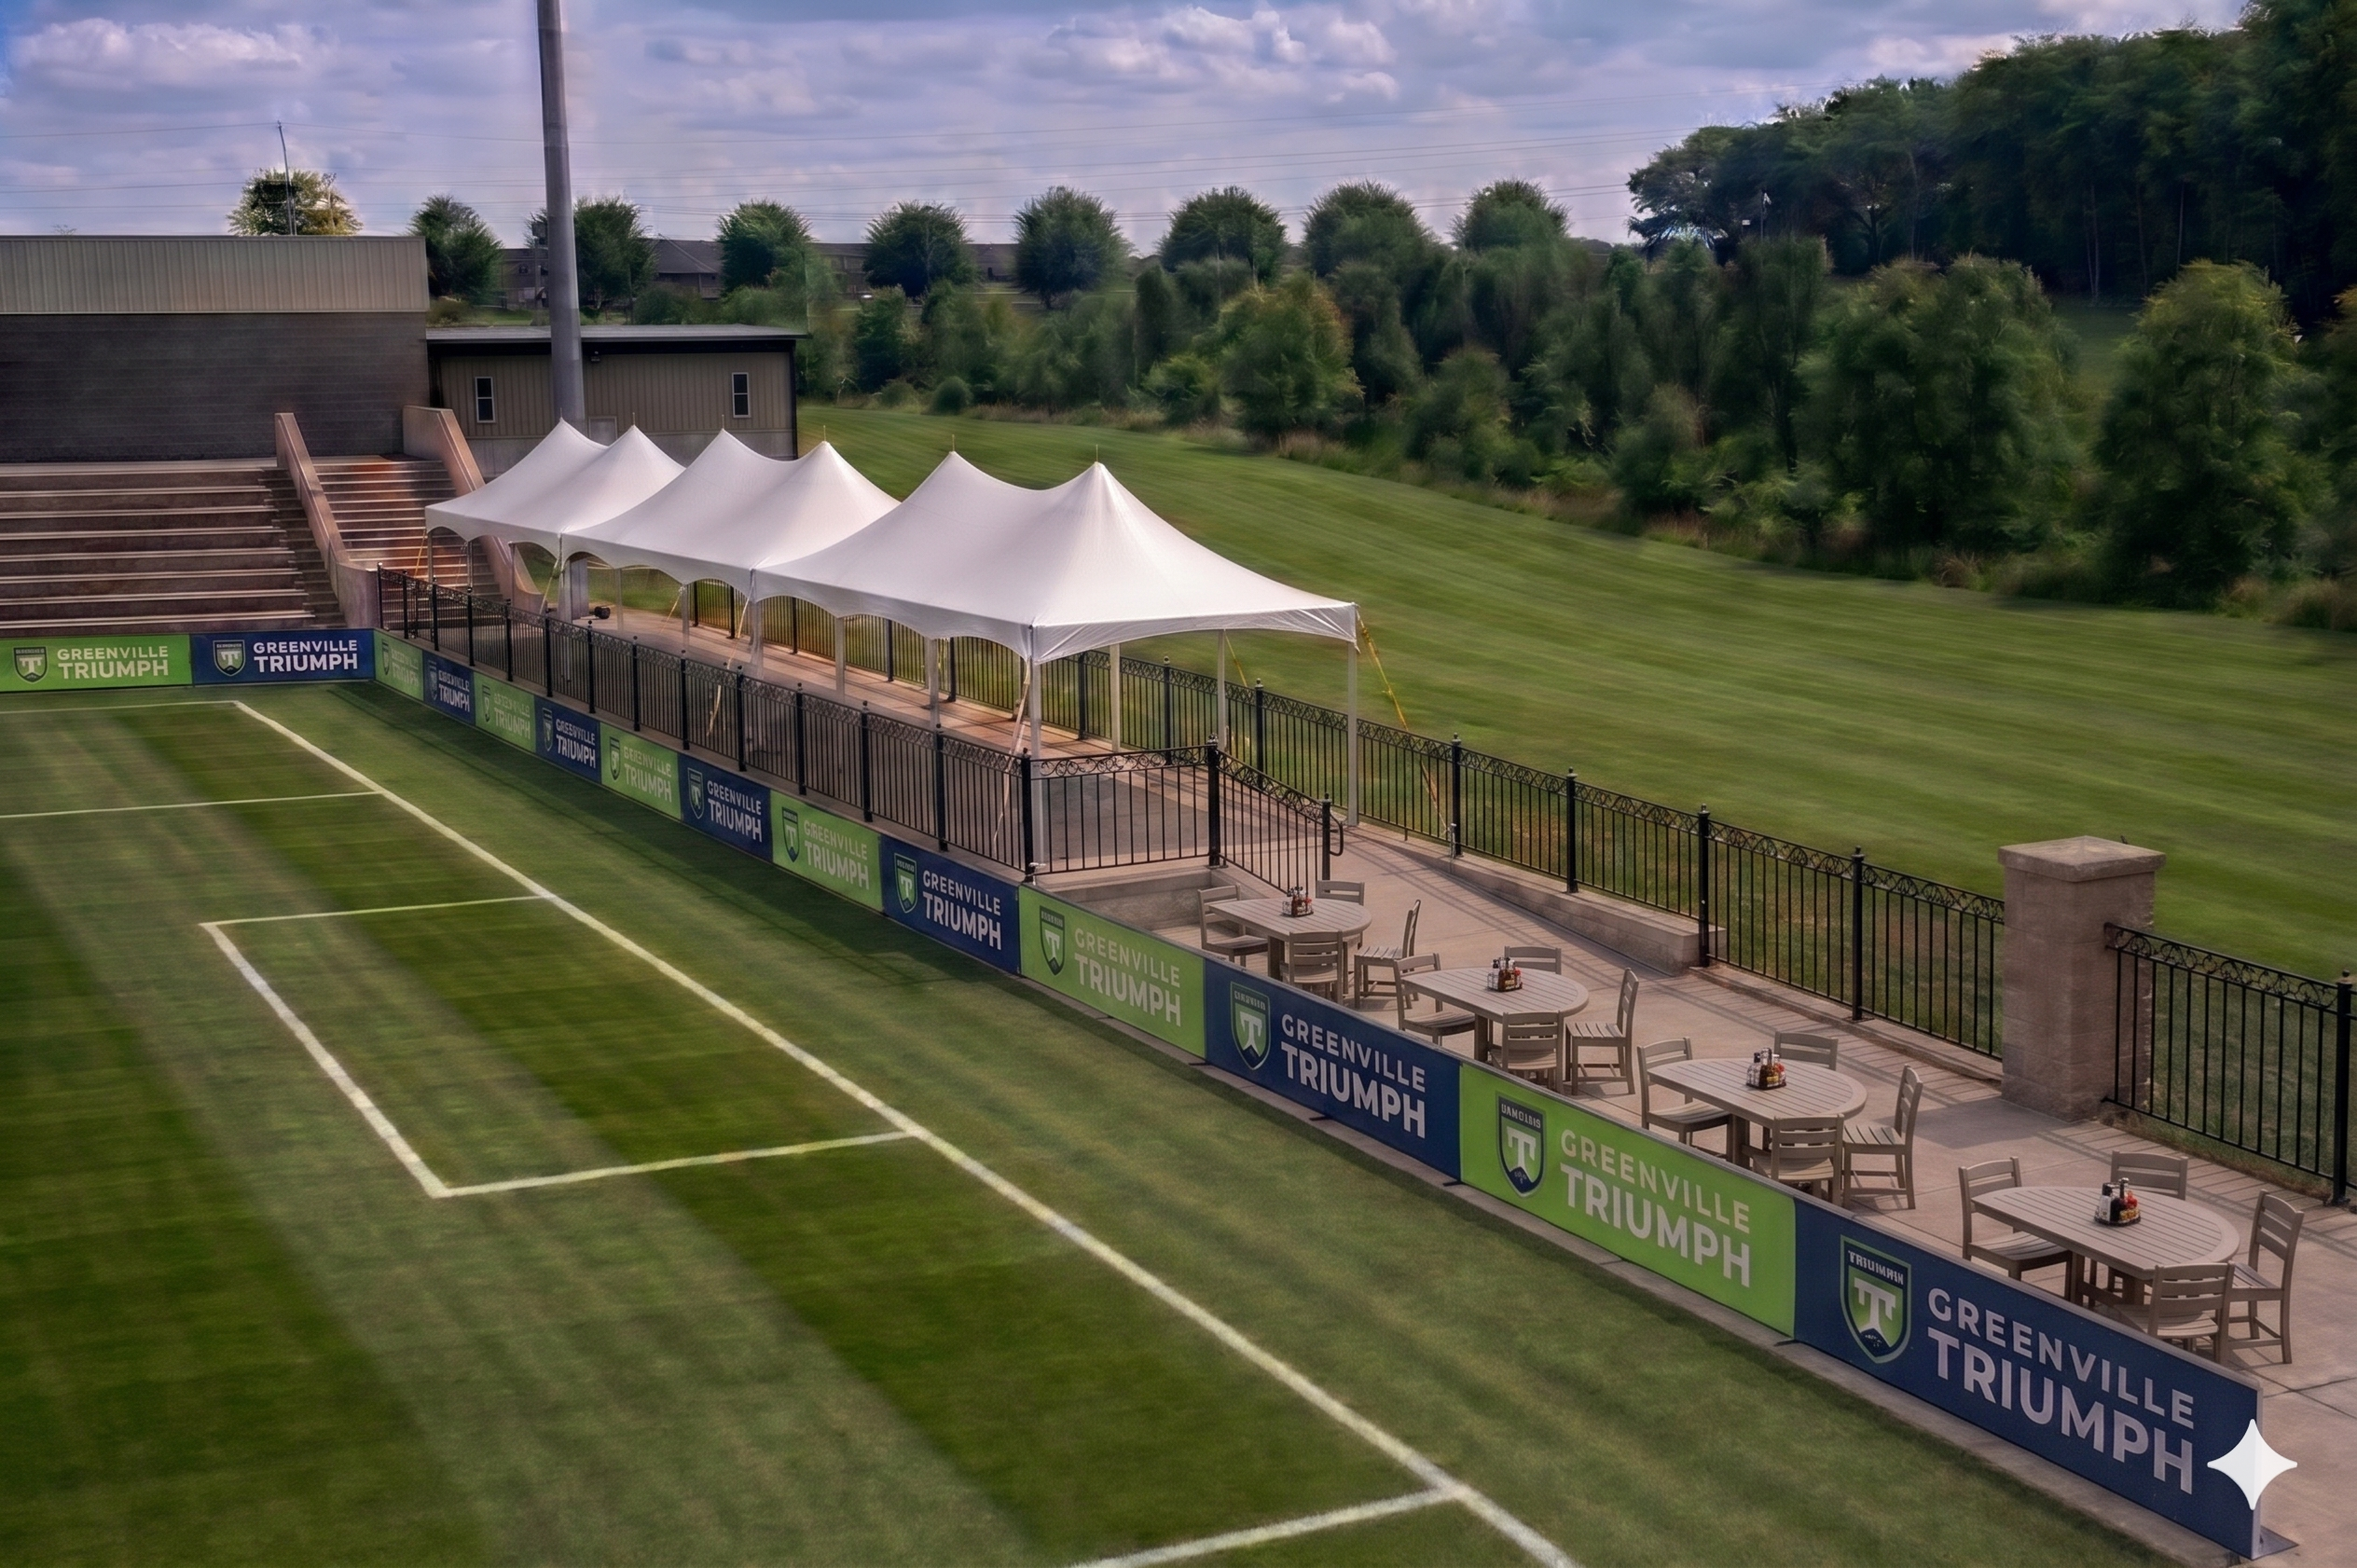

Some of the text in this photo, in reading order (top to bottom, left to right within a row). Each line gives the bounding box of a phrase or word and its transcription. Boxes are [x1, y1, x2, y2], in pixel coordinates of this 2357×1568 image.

[57, 645, 169, 662] GREENVILLE
[58, 659, 169, 680] TRIUMPH
[253, 640, 358, 654] GREENVILLE
[255, 653, 358, 673] TRIUMPH
[556, 734, 596, 768] TRIUMPH
[624, 763, 672, 803] TRIUMPH
[707, 780, 762, 816] GREENVILLE
[708, 799, 763, 843] TRIUMPH
[804, 842, 869, 890] TRIUMPH
[922, 870, 1001, 916] GREENVILLE
[922, 891, 1001, 951] TRIUMPH
[1074, 928, 1180, 988] GREENVILLE
[1074, 953, 1181, 1026] TRIUMPH
[1281, 1013, 1426, 1093] GREENVILLE
[1281, 1041, 1426, 1138] TRIUMPH
[1561, 1129, 1750, 1235] GREENVILLE
[1560, 1162, 1750, 1288] TRIUMPH
[1927, 1286, 2195, 1429] GREENVILLE
[1927, 1327, 2193, 1495] TRIUMPH
